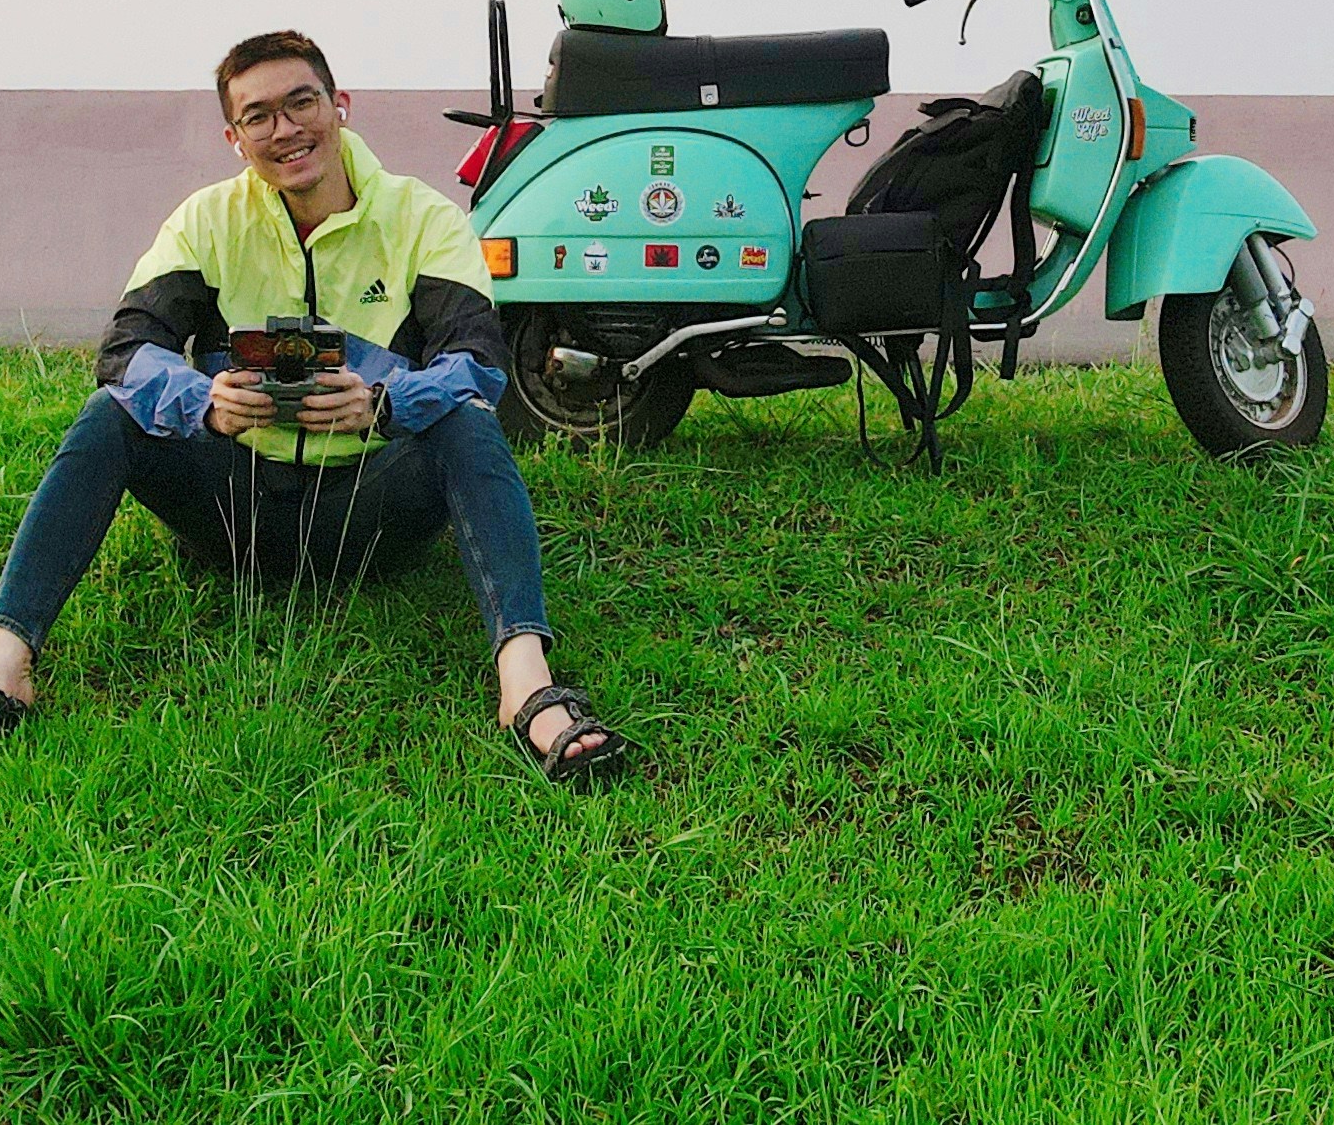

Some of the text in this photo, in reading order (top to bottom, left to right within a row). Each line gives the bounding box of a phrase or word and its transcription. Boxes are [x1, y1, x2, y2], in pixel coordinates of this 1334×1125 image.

[1071, 106, 1111, 123] Weed
[1076, 122, 1108, 142] Life
[574, 200, 618, 213] Weed!
[359, 294, 390, 304] adida
